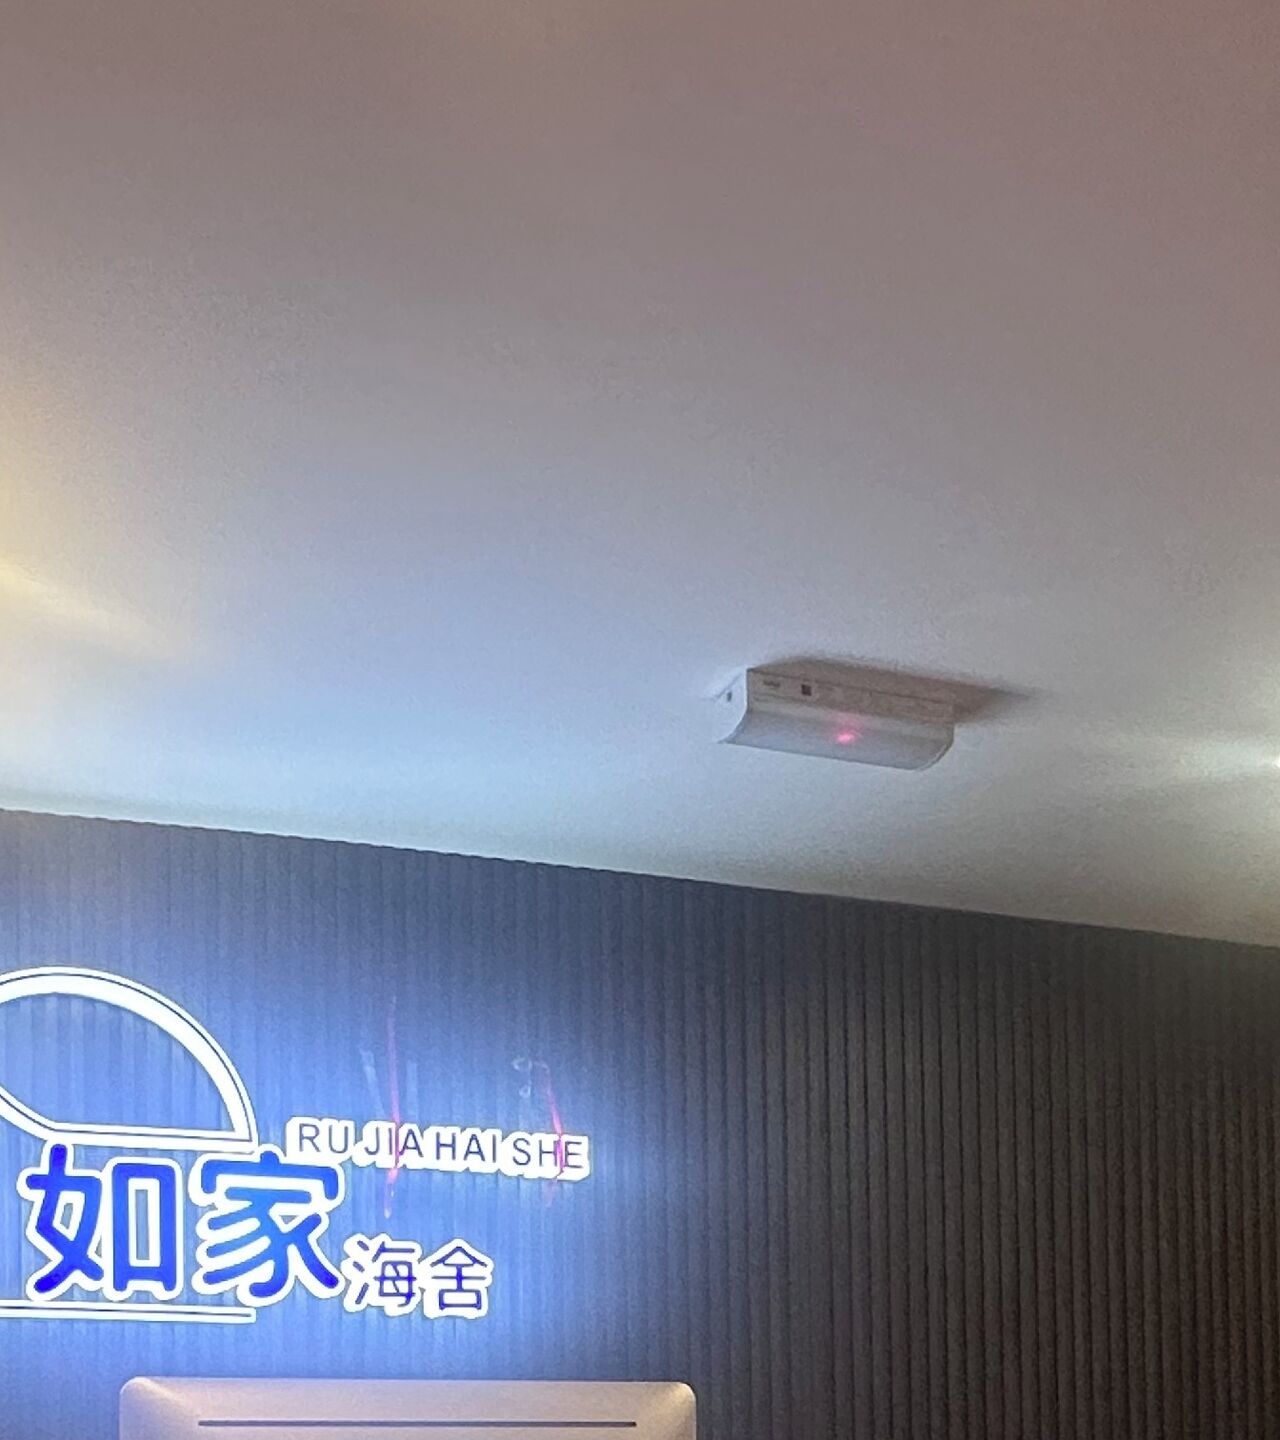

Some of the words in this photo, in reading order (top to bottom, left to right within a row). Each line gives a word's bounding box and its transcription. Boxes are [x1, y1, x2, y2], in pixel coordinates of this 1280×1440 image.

[295, 1121, 351, 1157] RU
[362, 1122, 426, 1161] JIA
[433, 1129, 498, 1165] HAI
[510, 1135, 585, 1172] SHE
[23, 1141, 341, 1299] 如家
[350, 1239, 489, 1312] 海舍
